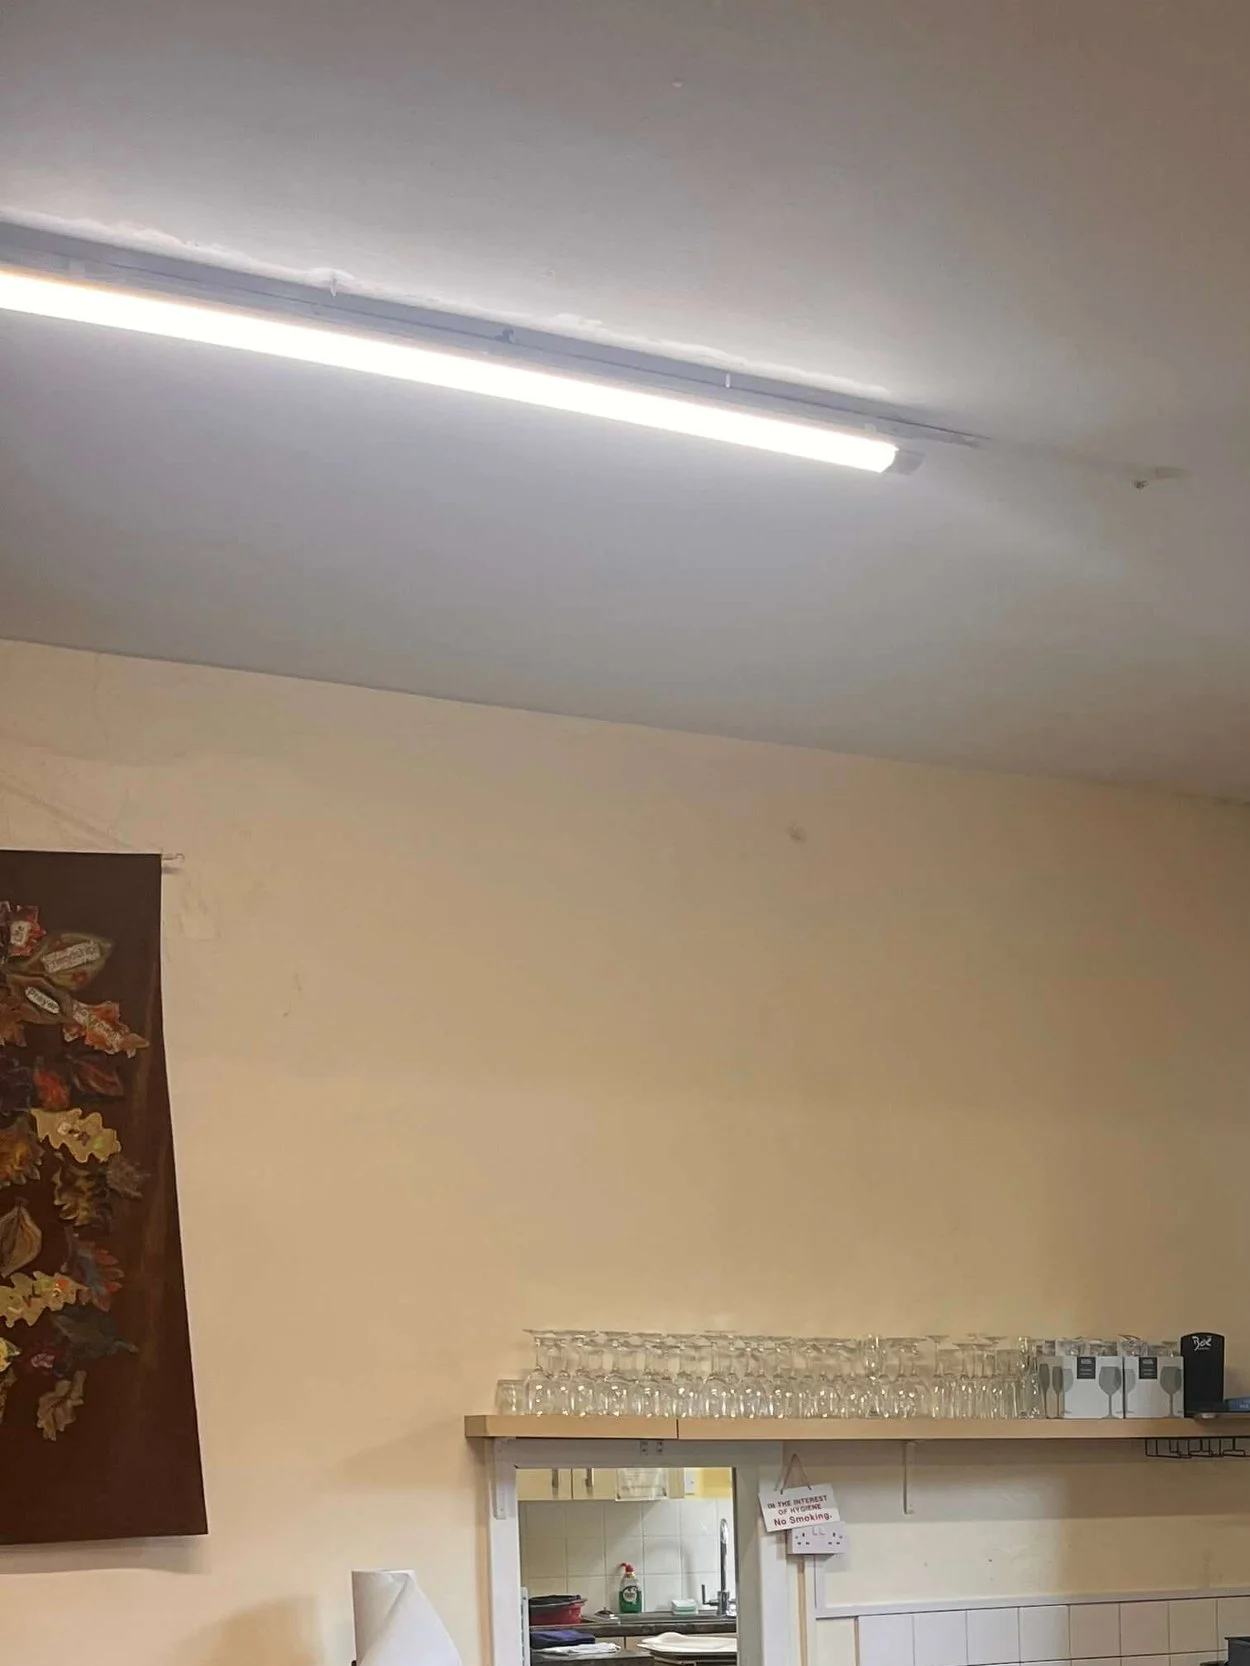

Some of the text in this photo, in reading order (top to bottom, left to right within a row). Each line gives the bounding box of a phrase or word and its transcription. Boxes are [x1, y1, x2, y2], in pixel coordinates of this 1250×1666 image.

[777, 1499, 791, 1508] THE
[794, 1495, 827, 1505] INTEREST
[778, 1503, 822, 1516] OF HYGIENE
[773, 1517, 787, 1526] No
